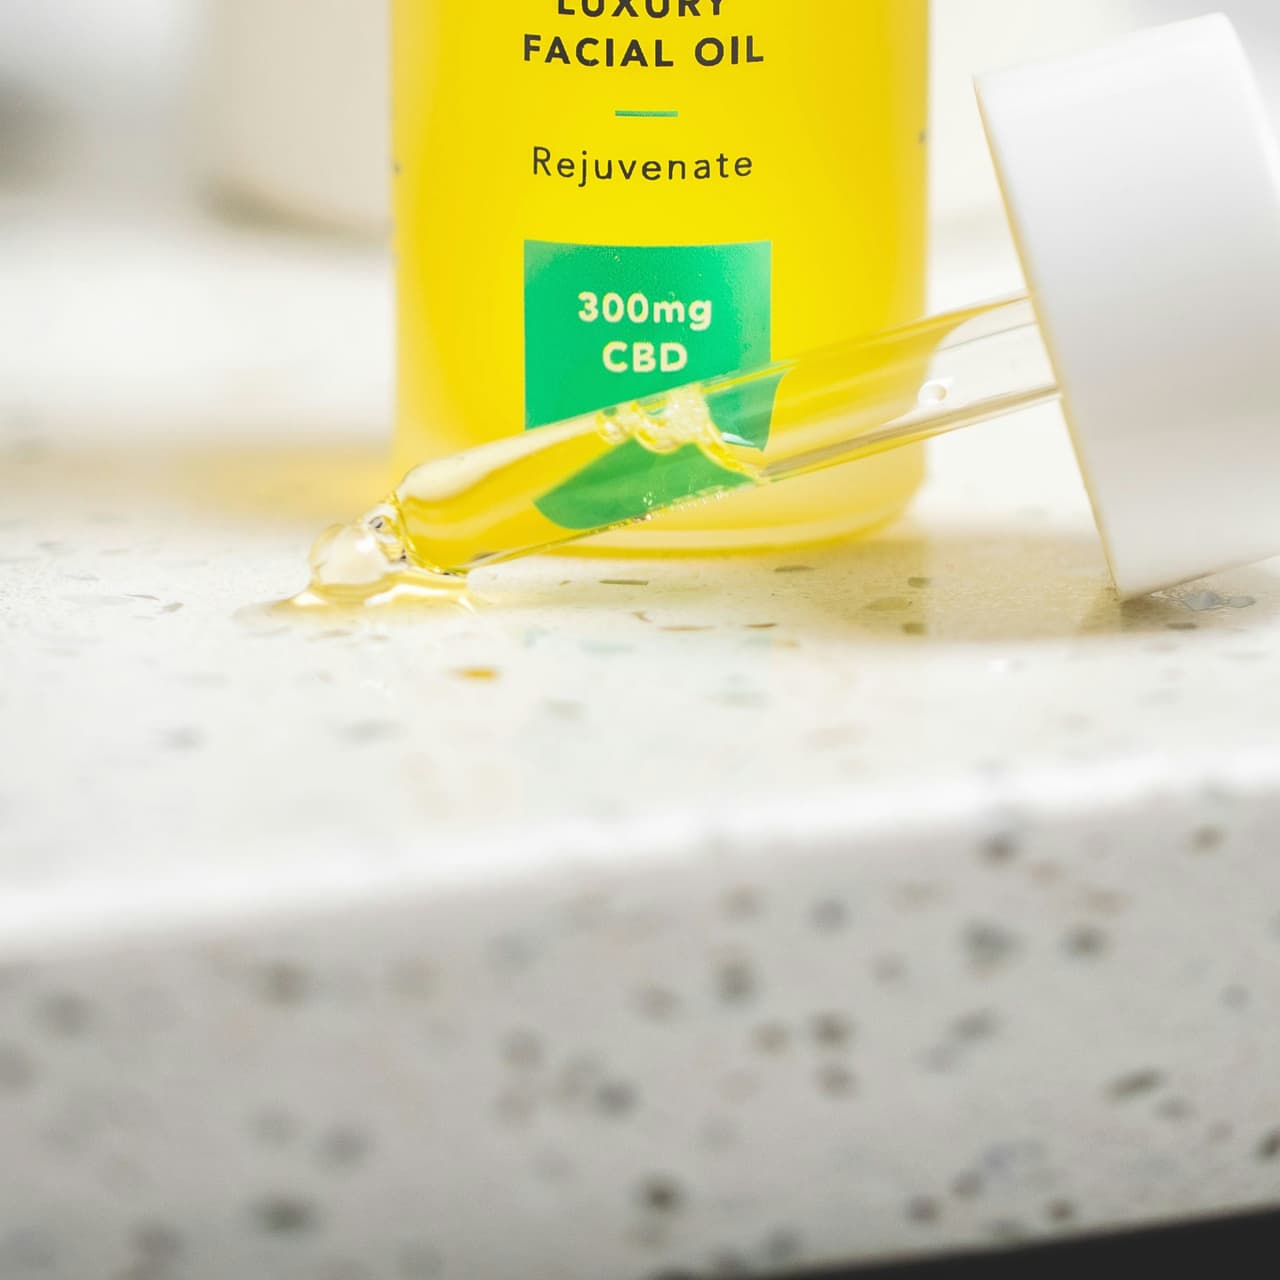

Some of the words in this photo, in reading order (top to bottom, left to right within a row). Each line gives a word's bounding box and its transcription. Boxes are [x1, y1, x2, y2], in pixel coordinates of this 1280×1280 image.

[523, 33, 674, 68] FACIAL
[694, 35, 765, 67] OIL
[532, 146, 754, 188] Rejuvenate
[577, 291, 713, 332] 300mg
[601, 341, 689, 373] CBD
